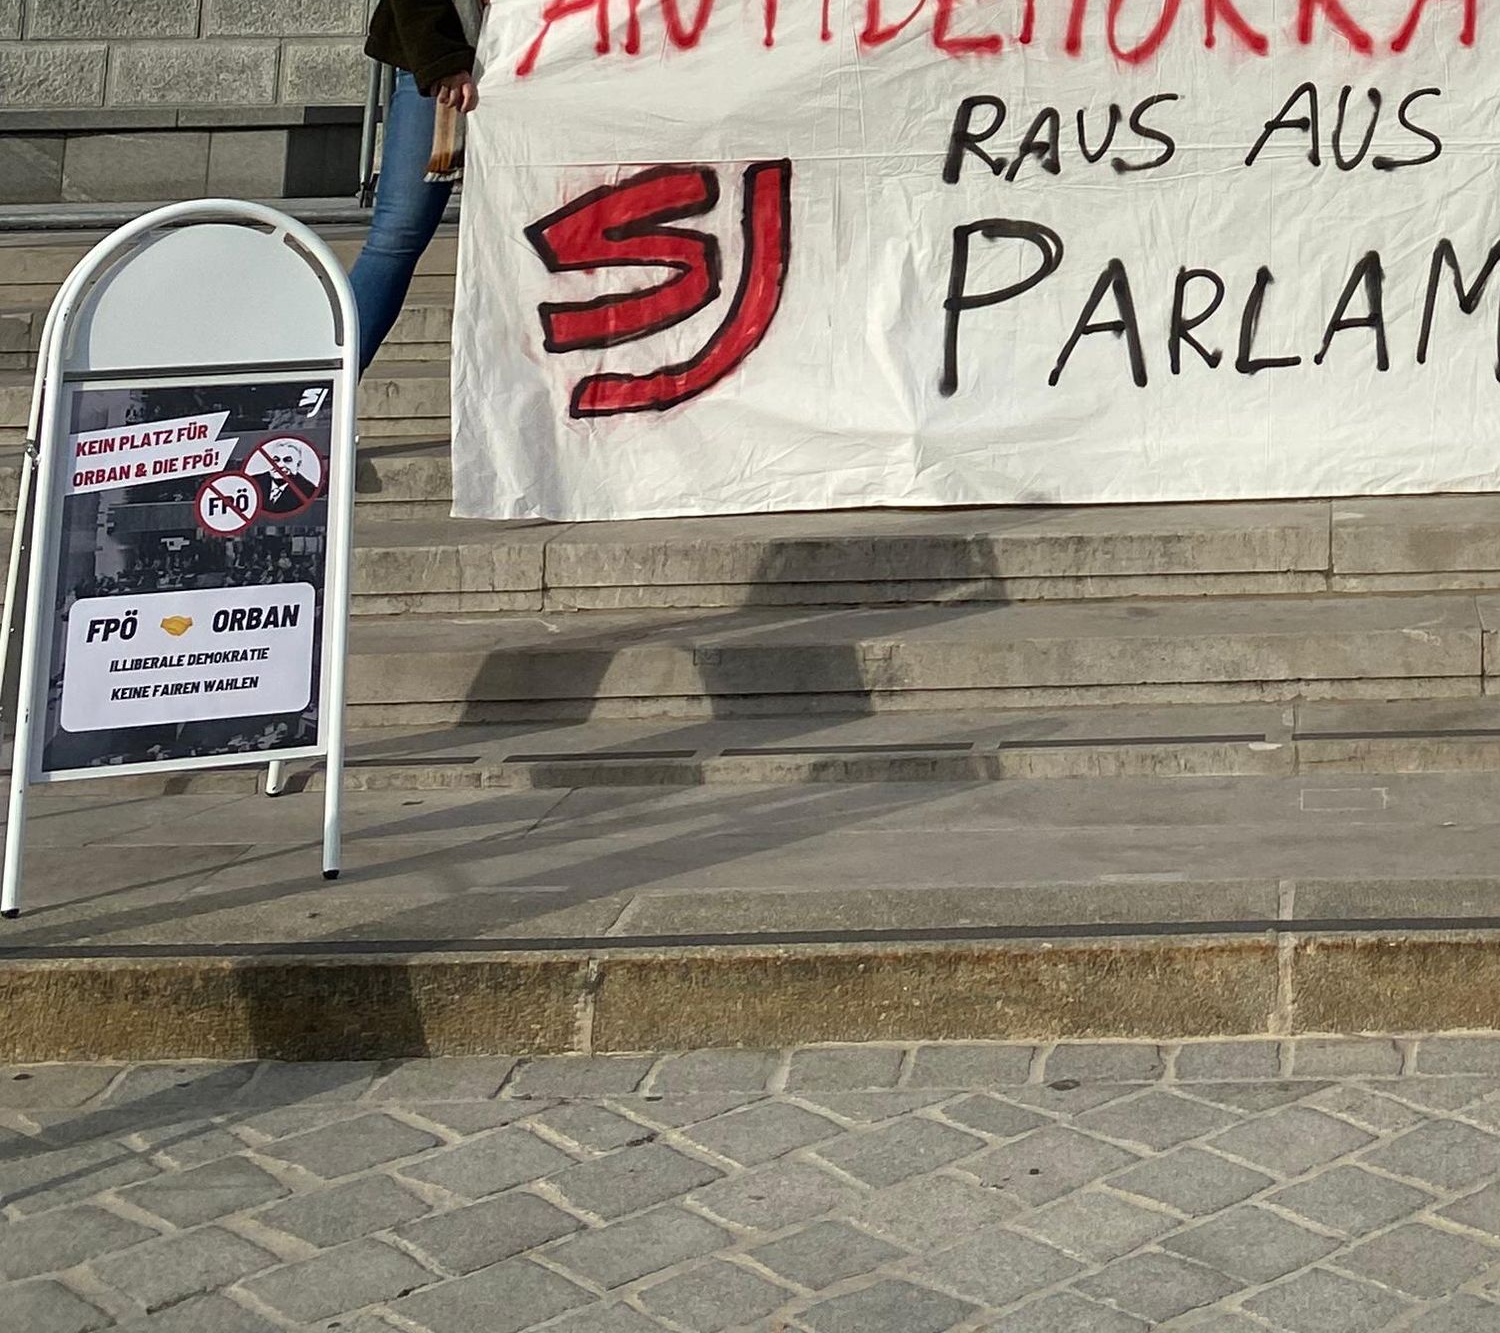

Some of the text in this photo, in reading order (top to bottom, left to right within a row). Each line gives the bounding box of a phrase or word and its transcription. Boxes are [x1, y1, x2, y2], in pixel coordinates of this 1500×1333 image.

[942, 94, 1177, 183] RAUS
[1245, 82, 1442, 171] AUS
[524, 157, 792, 419] SJ
[75, 422, 208, 457] KEIN PLATZ FÜR
[73, 448, 219, 487] ORBAN & DIE FPÖ!
[208, 488, 249, 516] FPÖ
[86, 604, 300, 643] FPÖ ORBAN
[109, 647, 270, 673] ILLIBERALE DEMOKRATIE
[111, 676, 259, 701] KEINE FAIREN WAHLEN
